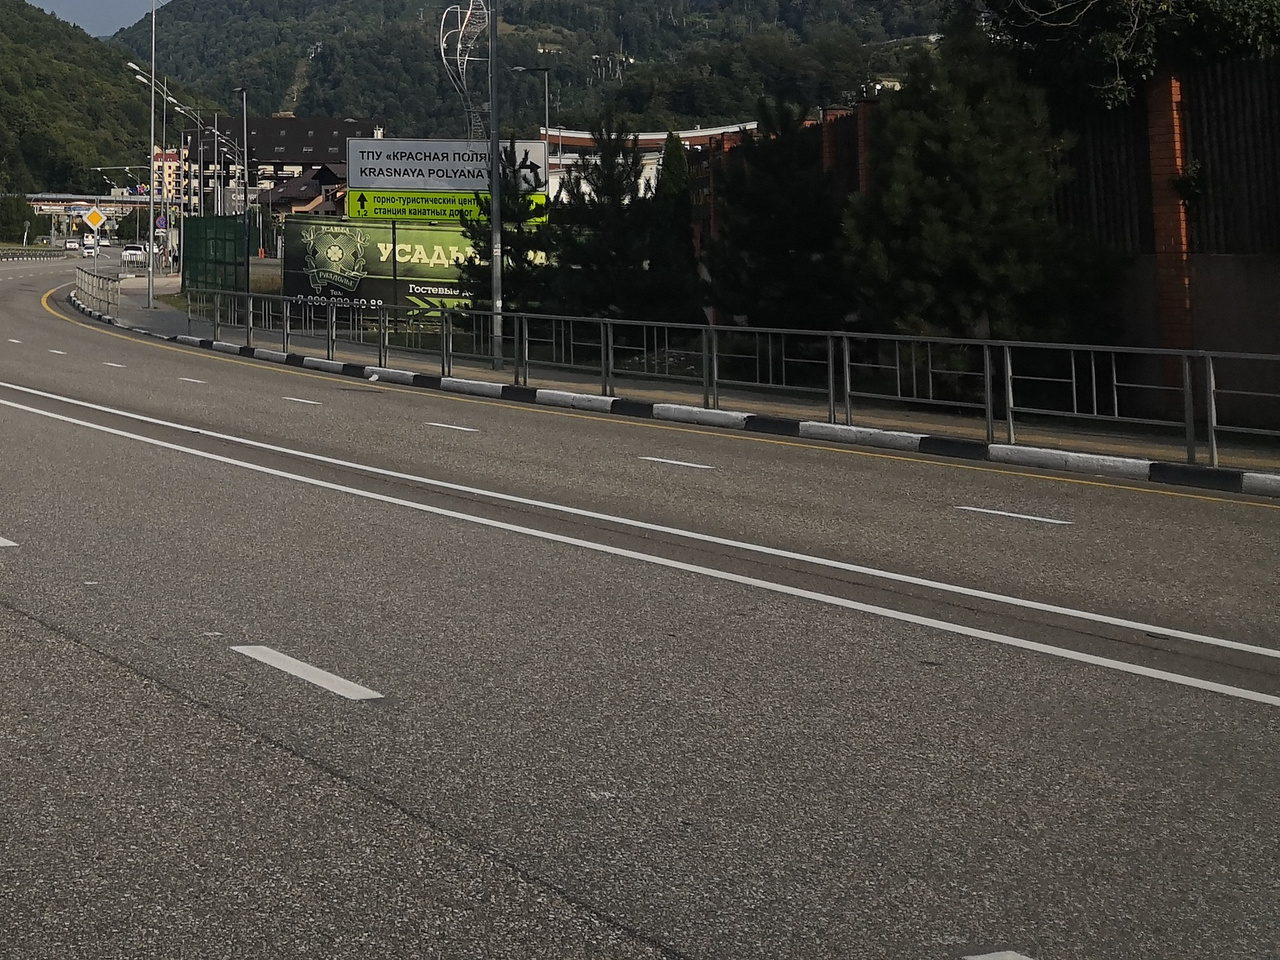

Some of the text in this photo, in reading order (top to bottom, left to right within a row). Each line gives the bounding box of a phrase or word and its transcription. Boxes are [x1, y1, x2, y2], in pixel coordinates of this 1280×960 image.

[359, 150, 383, 161] ТПУ
[386, 151, 449, 162] «КРАСНАЯ
[360, 167, 425, 178] KRASNAYA
[428, 168, 485, 180] POLYANA
[373, 195, 457, 206] горно-туристический
[374, 207, 407, 217] станция
[408, 208, 447, 217] канатных
[448, 208, 473, 218] дорог
[409, 284, 460, 296] Гостевые
